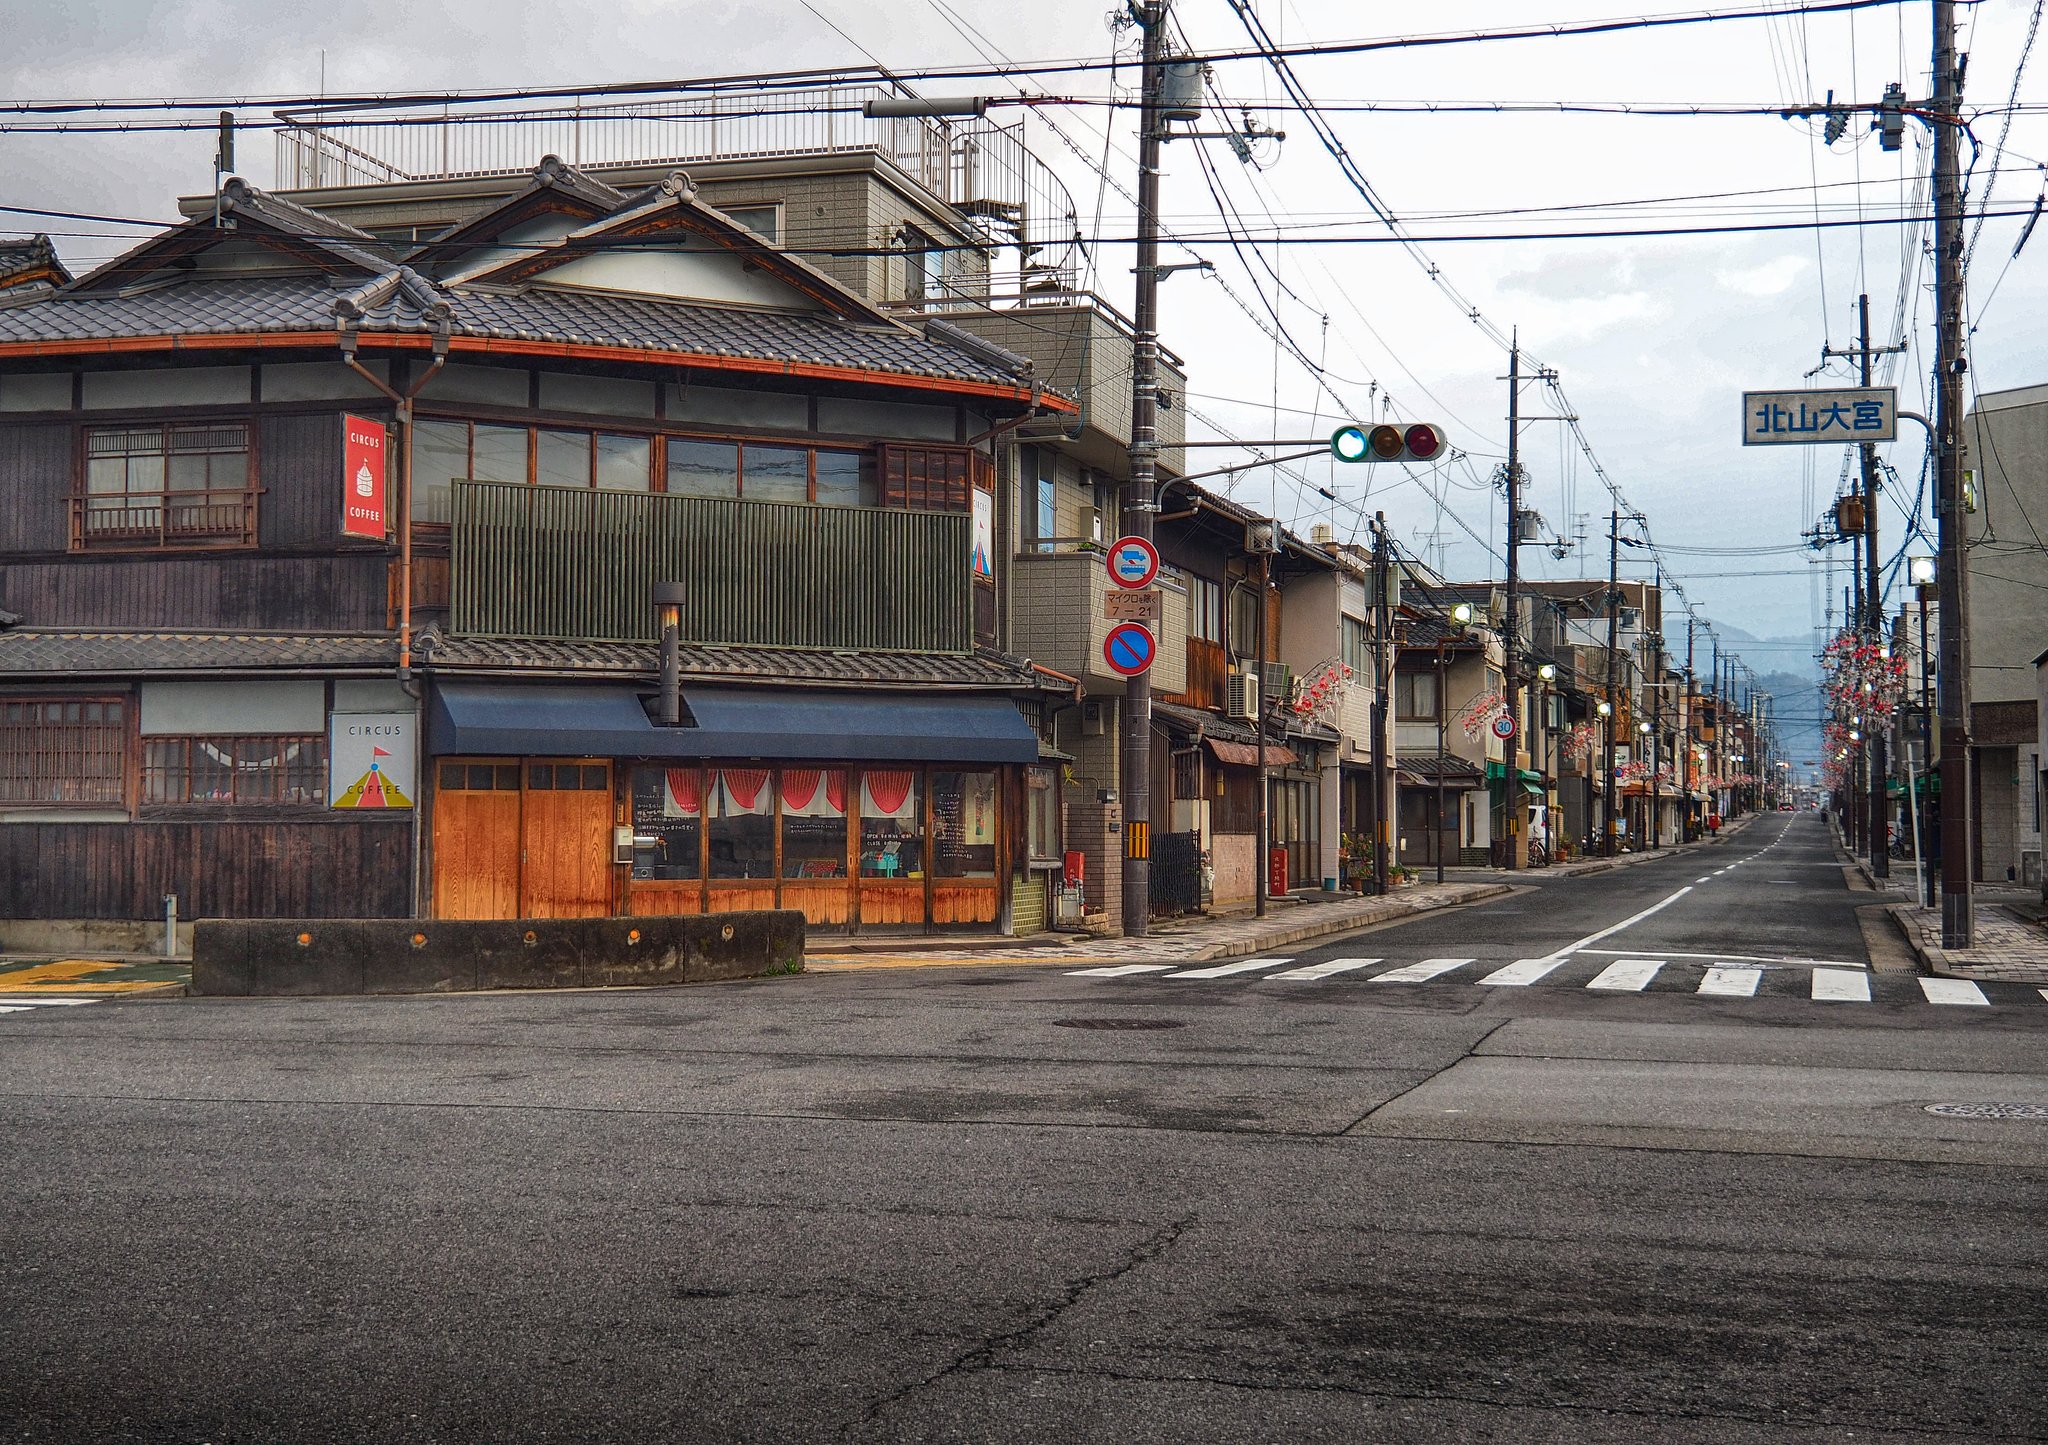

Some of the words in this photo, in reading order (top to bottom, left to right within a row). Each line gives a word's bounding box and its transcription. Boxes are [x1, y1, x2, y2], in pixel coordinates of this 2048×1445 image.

[1755, 399, 1884, 433] 北山大宮
[350, 432, 380, 448] CIRCUS
[349, 506, 380, 522] COFFEE
[1107, 593, 1157, 604] マイクロを除く
[348, 726, 401, 736] CIRCUS
[1497, 721, 1511, 732] 30
[347, 785, 401, 795] COFFEE
